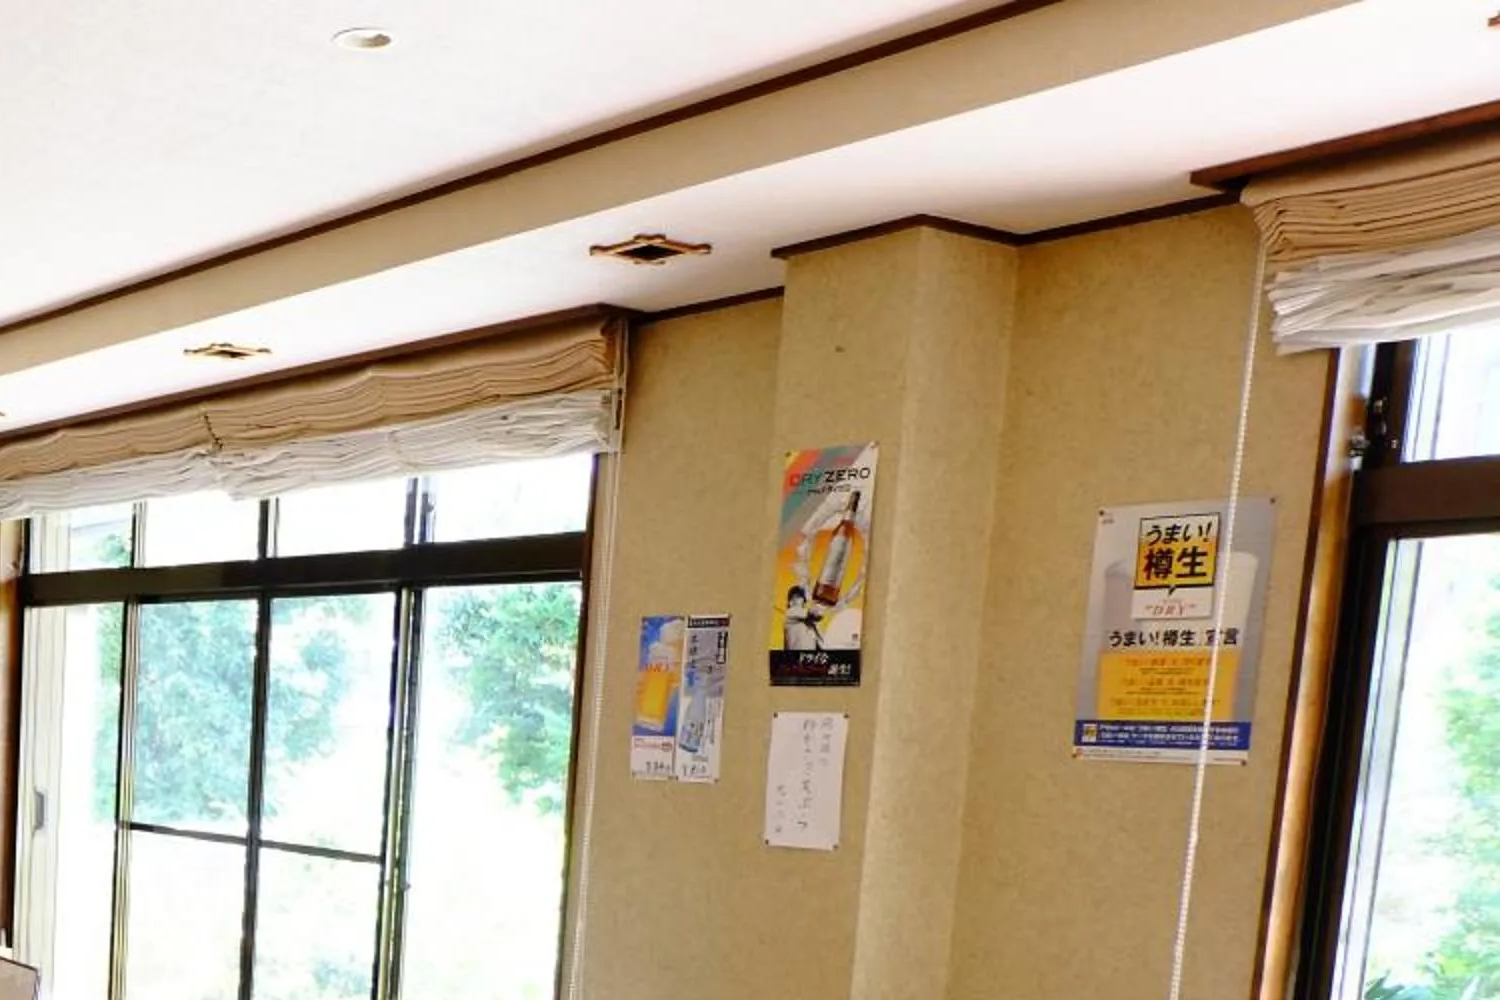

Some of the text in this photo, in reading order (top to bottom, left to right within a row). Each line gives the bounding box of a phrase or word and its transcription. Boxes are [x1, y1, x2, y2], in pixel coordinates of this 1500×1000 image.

[1146, 522, 1212, 546] うまい!
[1143, 545, 1208, 580] 樽生
